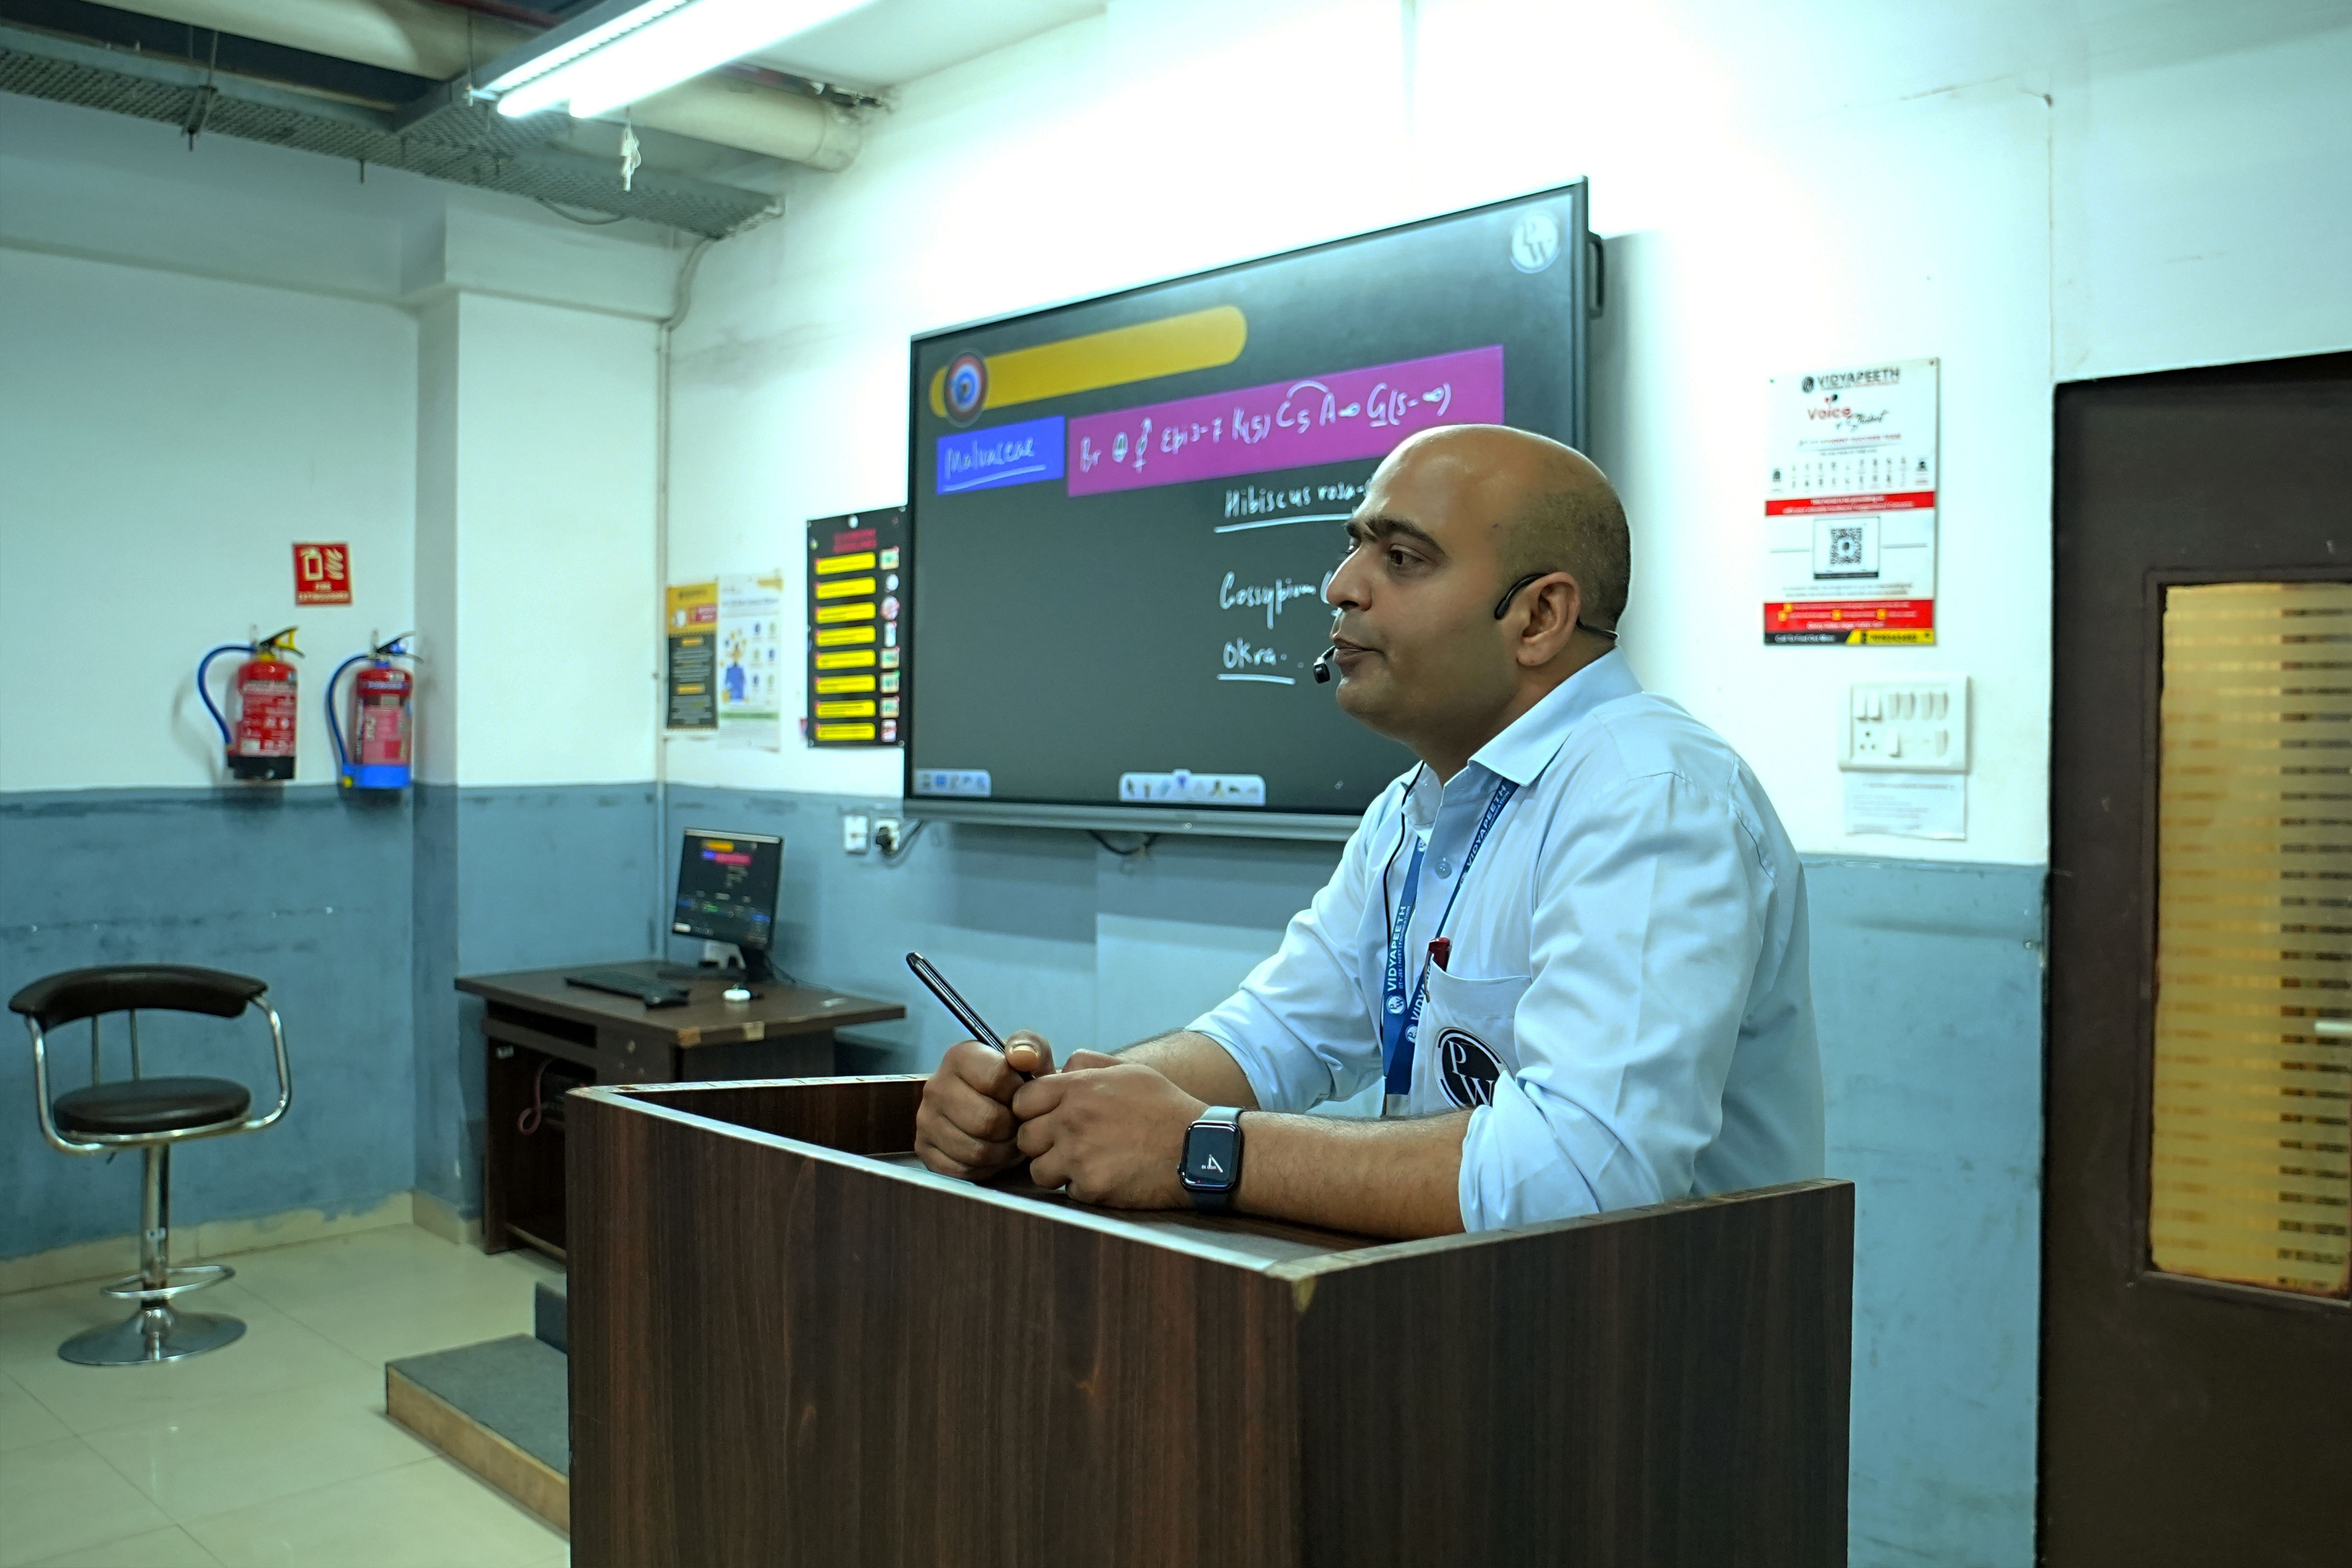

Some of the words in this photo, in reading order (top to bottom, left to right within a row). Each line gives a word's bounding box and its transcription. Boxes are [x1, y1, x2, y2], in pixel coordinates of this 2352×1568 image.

[1817, 366, 1900, 387] VIDYAPEETH
[1224, 485, 1311, 518] Hibiscus
[1466, 785, 1507, 867] VIDYAPEETH
[1387, 906, 1406, 992] VIDYAPEETH
